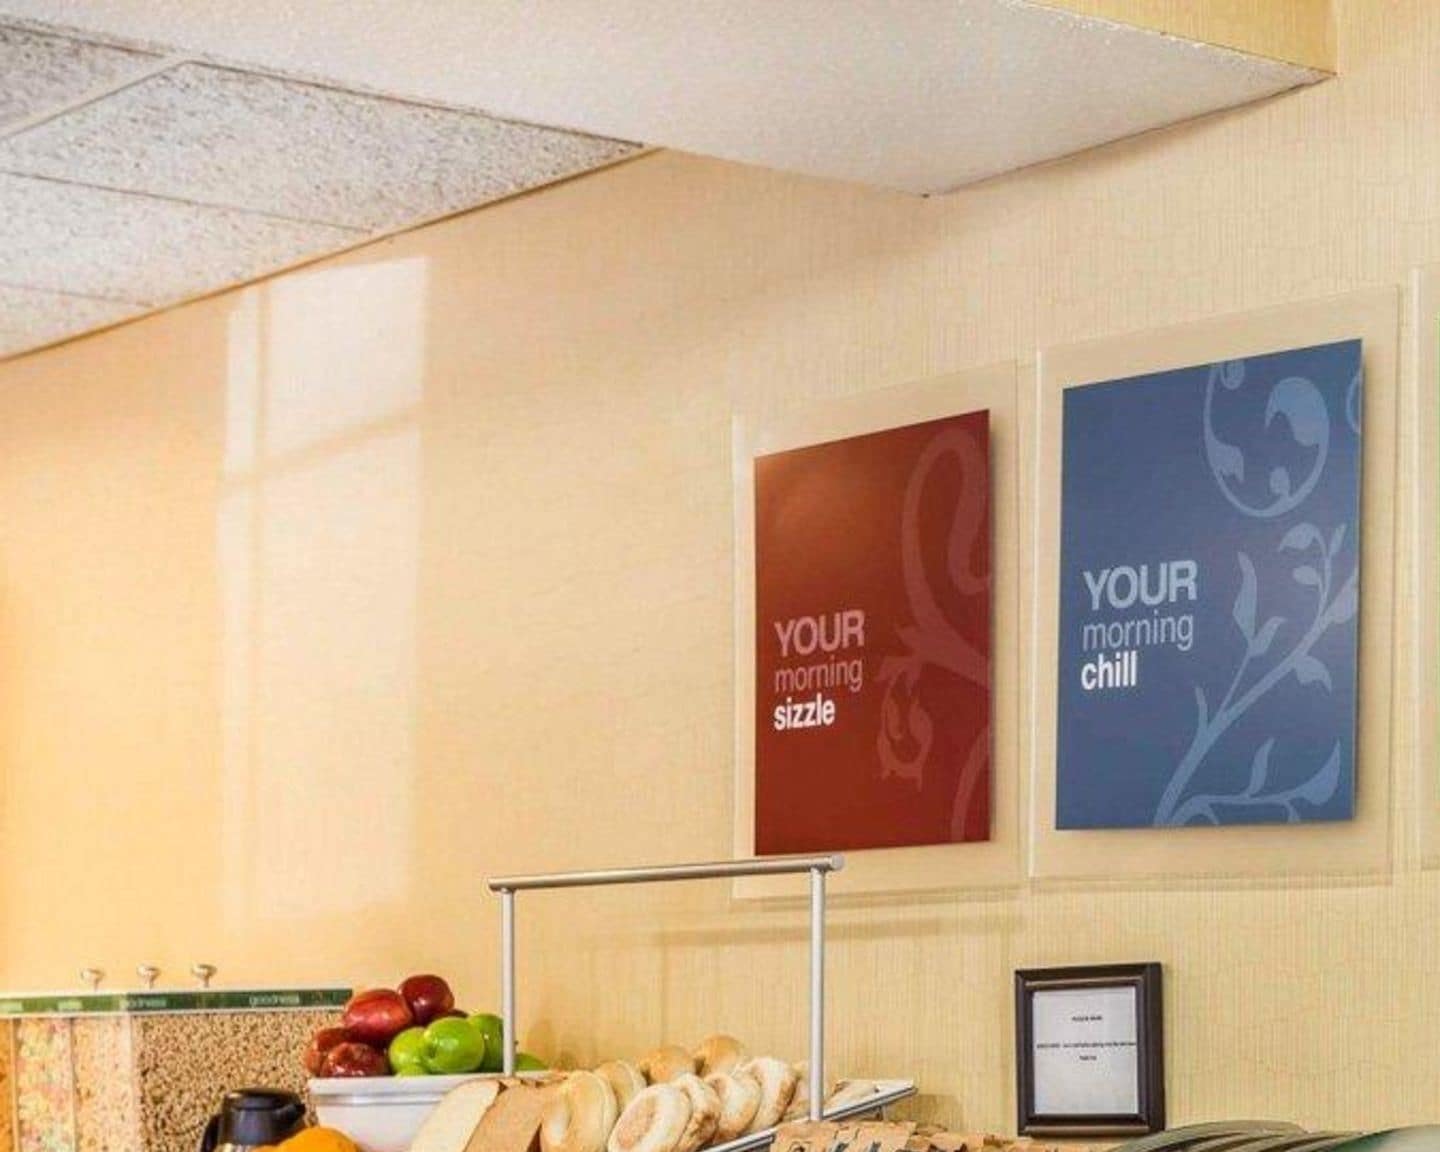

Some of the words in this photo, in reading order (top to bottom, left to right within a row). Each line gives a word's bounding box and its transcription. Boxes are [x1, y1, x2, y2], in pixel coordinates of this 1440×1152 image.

[1083, 560, 1198, 610] YOUR
[774, 609, 865, 656] YOUR
[1083, 612, 1194, 652] morning
[774, 655, 863, 693] morning
[1081, 652, 1137, 691] chill
[773, 694, 835, 731] sizzle
